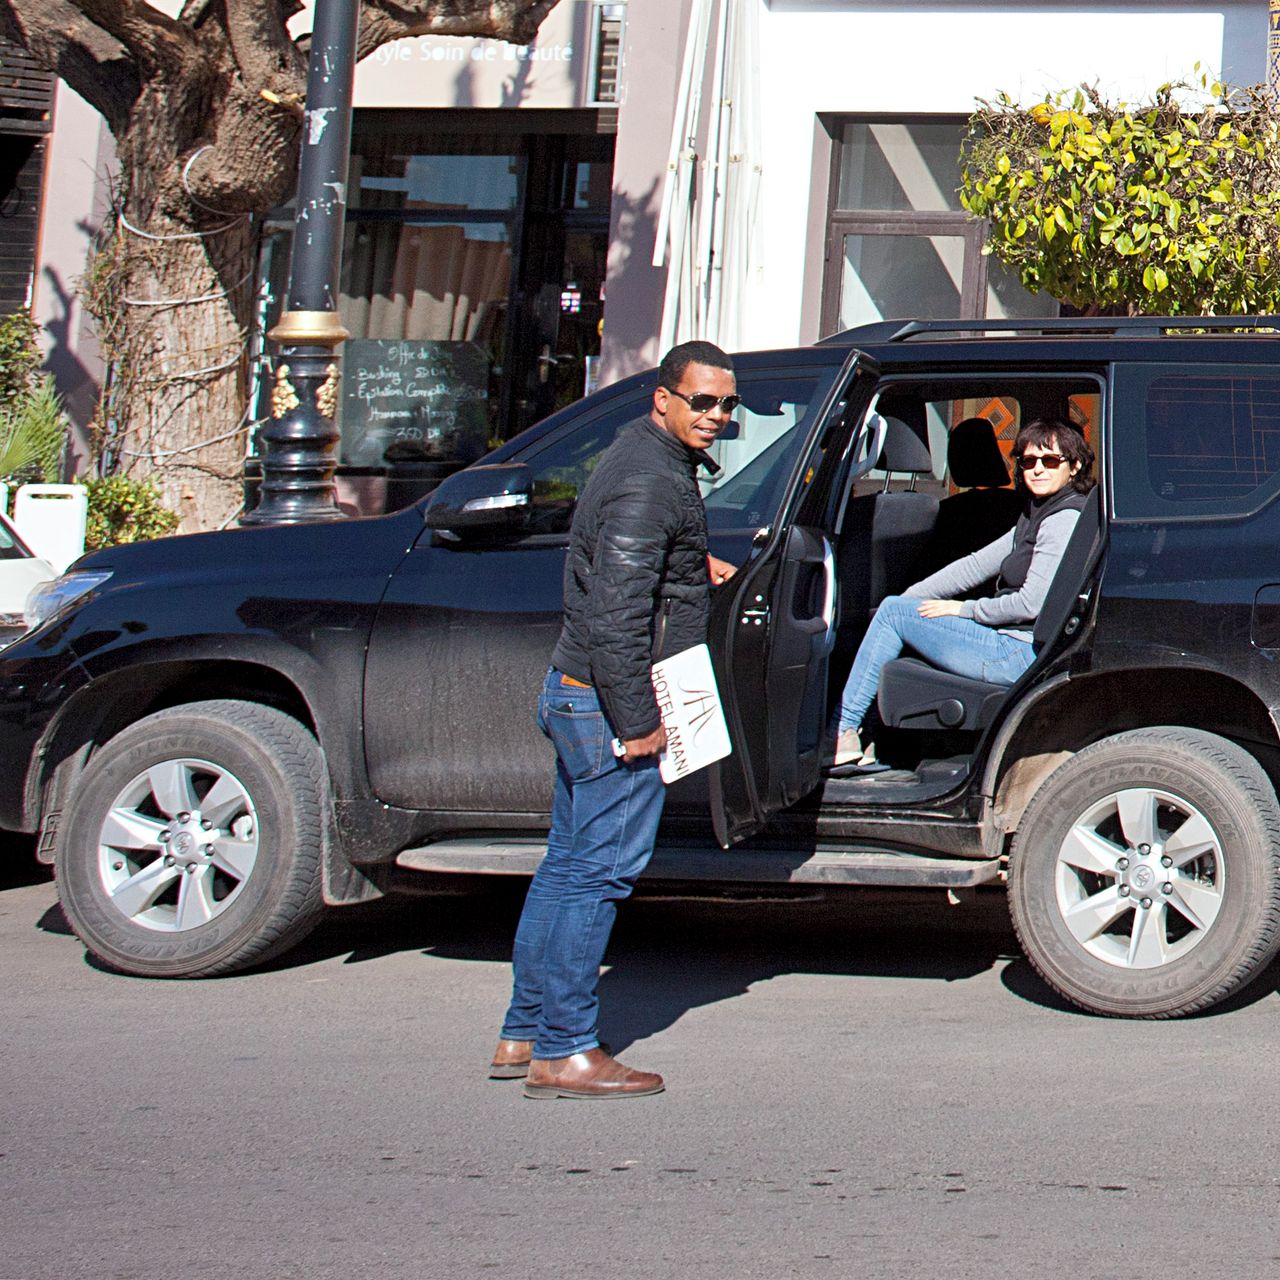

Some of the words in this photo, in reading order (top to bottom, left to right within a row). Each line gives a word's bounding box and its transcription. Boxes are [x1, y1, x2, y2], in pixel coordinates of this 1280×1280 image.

[420, 42, 464, 61] Soin
[471, 42, 497, 61] de
[503, 42, 573, 61] beauté
[651, 668, 675, 724] HOTEL
[665, 726, 690, 777] AMANI
